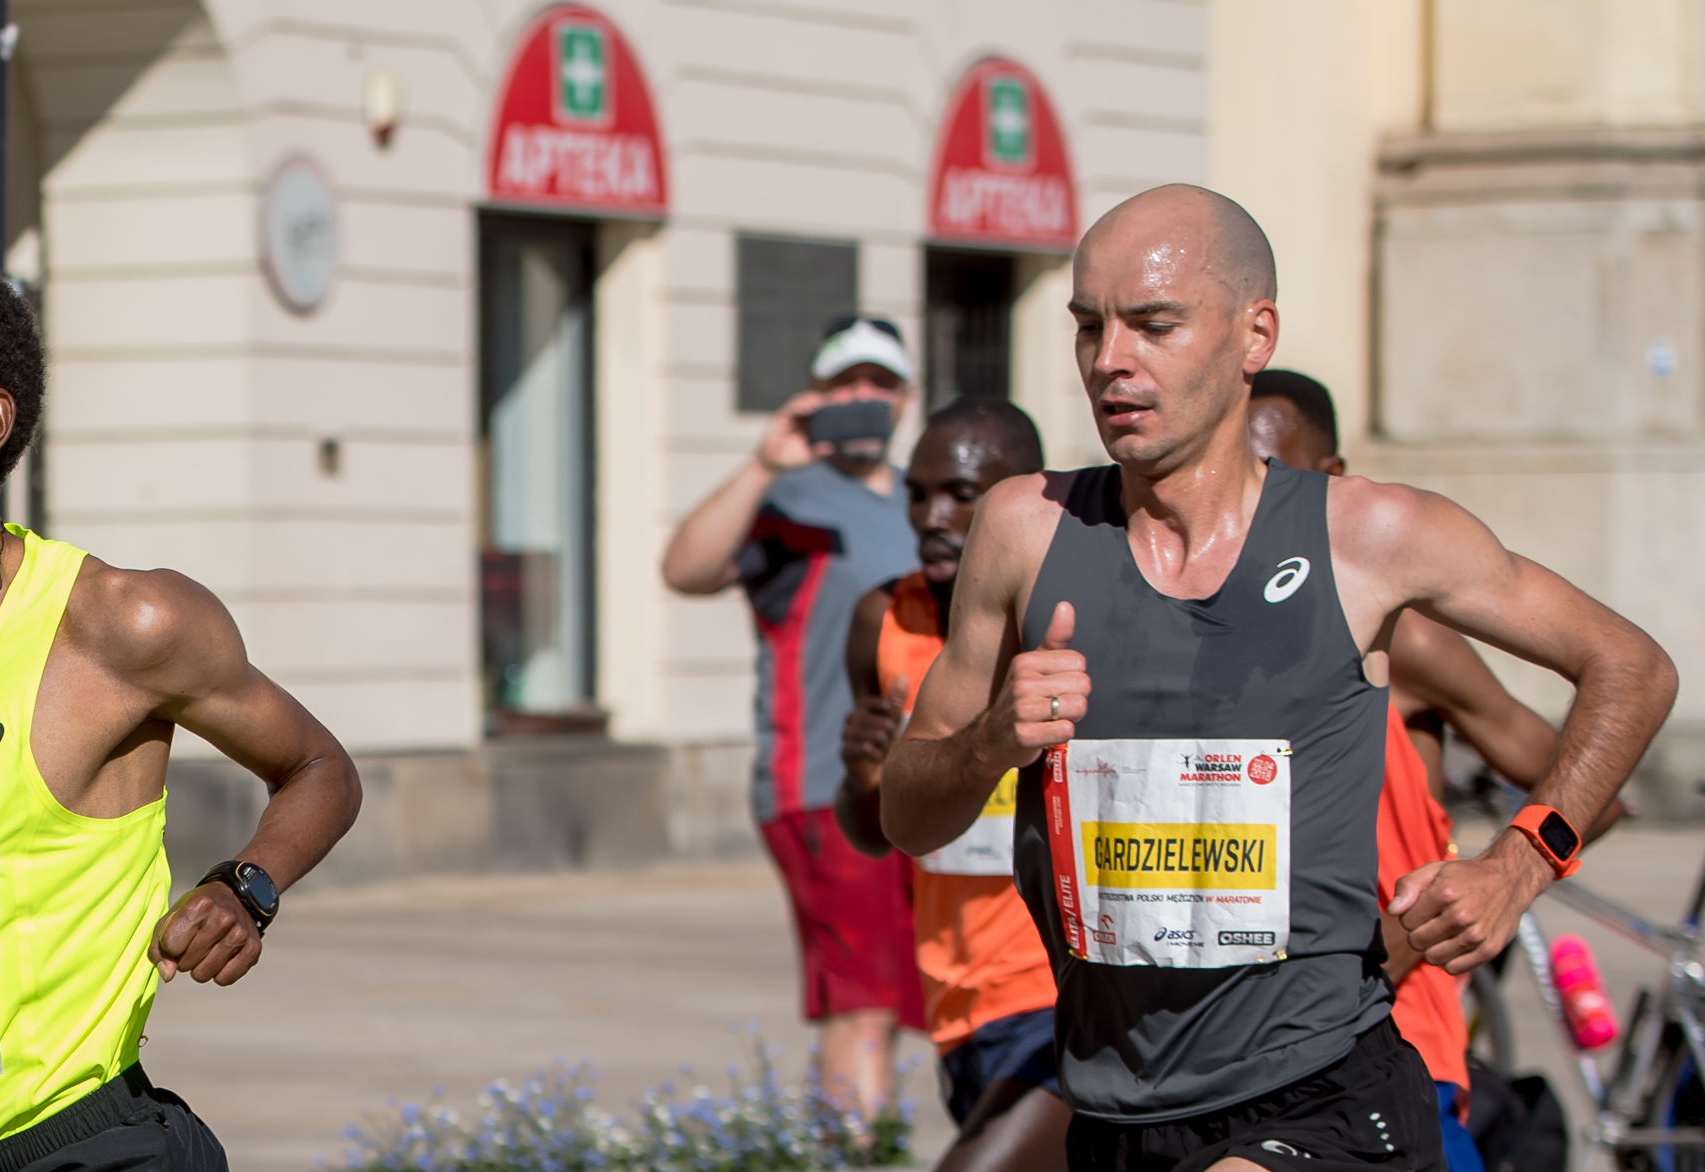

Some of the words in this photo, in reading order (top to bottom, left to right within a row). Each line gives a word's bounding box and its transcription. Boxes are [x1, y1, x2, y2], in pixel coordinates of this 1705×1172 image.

[501, 126, 655, 197] APTEKA
[942, 170, 1068, 232] APTEKA
[1205, 754, 1241, 763] ORLEN
[1195, 763, 1241, 772] WARSAW
[1180, 773, 1241, 782] MARATHON
[1094, 836, 1265, 873] GARDZIELEWSKI
[1220, 933, 1273, 944] OSHEE
